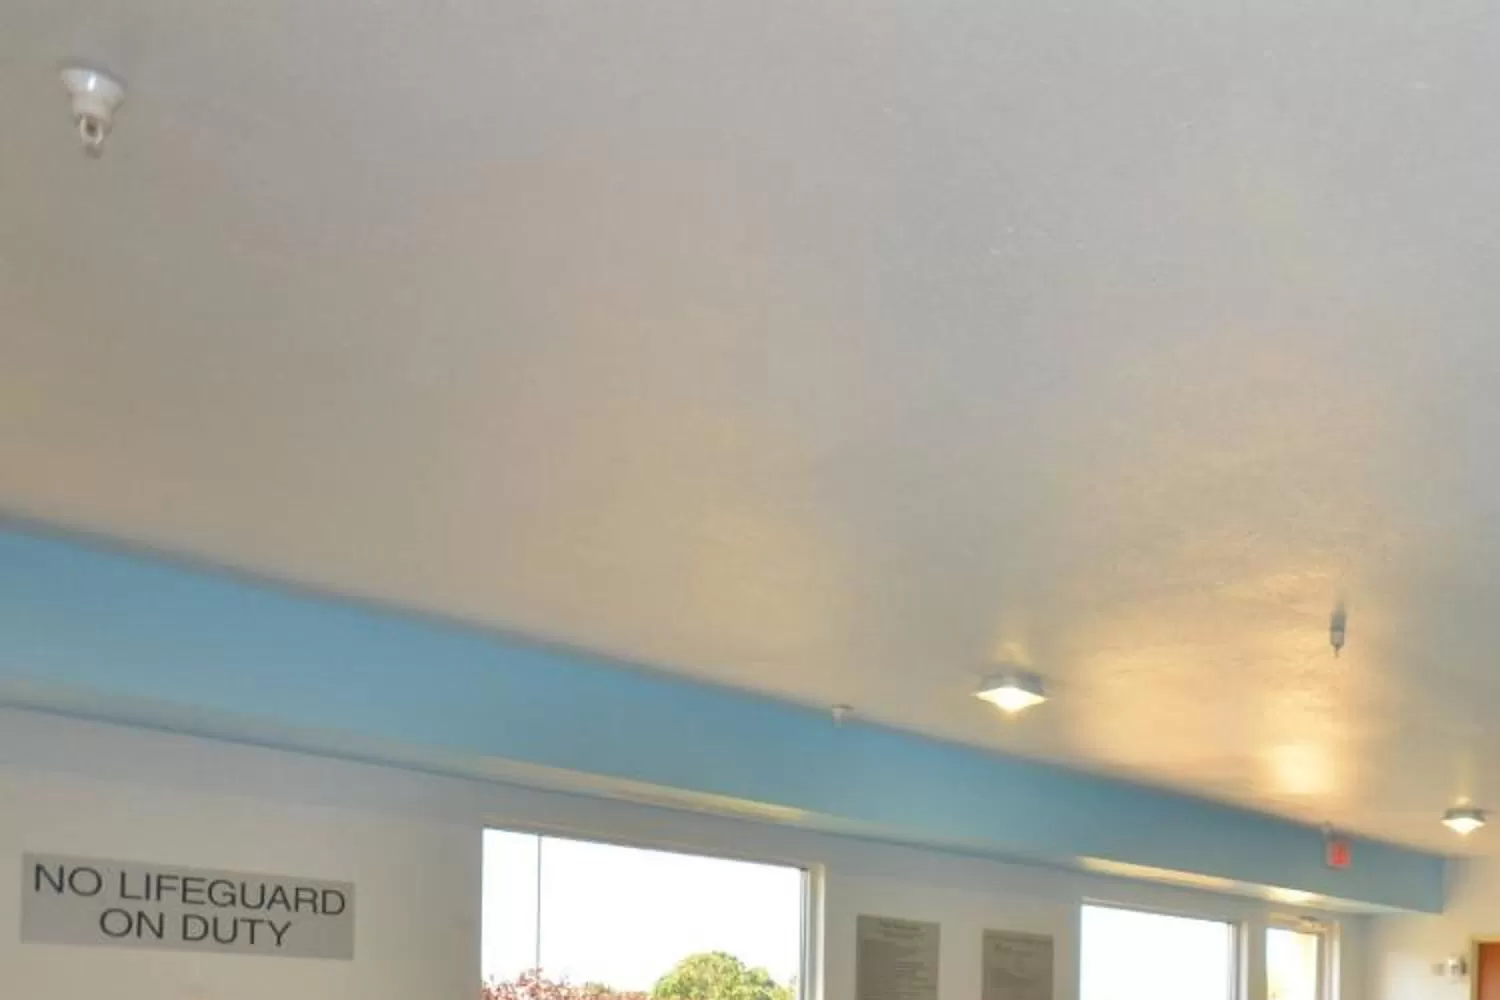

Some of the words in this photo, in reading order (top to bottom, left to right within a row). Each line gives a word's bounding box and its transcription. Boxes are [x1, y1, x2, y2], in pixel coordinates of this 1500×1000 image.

[34, 863, 102, 897] NO
[119, 871, 346, 915] LIFEGUARD
[99, 907, 165, 940] ON
[181, 914, 292, 946] DUTY
